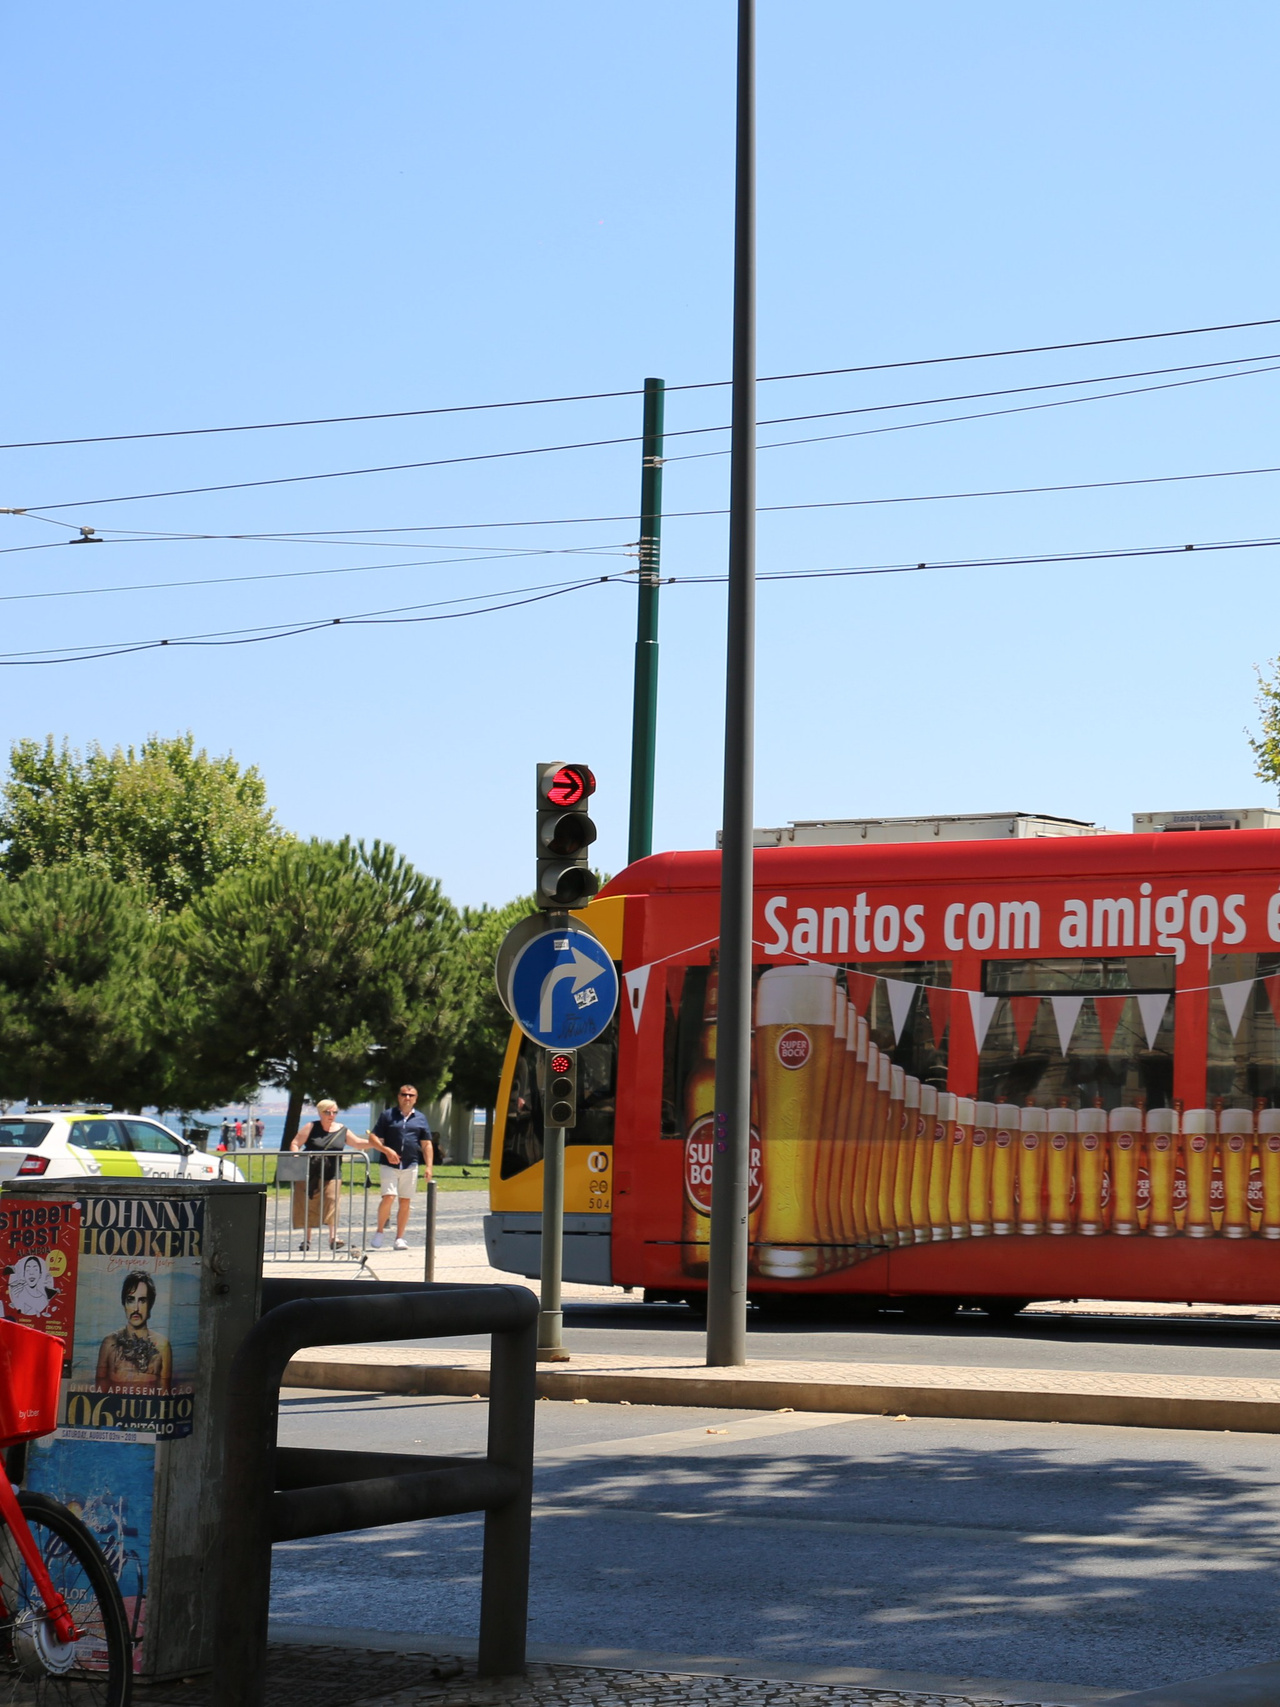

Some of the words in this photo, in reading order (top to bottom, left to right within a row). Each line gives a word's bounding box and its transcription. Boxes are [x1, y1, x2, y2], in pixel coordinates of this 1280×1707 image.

[763, 891, 926, 955] Santos
[943, 900, 1041, 951] com
[1058, 882, 1247, 966] amigos
[781, 1040, 807, 1049] SUPER
[781, 1049, 806, 1058] BOCK
[688, 1143, 761, 1167] SUR
[690, 1164, 758, 1187] BOK
[79, 1199, 202, 1229] JOHNNY
[589, 1198, 609, 1209] 504
[79, 1228, 201, 1257] HOOKER
[70, 1383, 103, 1394] ÚNICA
[108, 1385, 193, 1398] APRESENTAÇÃO
[67, 1395, 114, 1428] 06
[116, 1398, 193, 1420] JULHO
[89, 1431, 109, 1440] AUGUST
